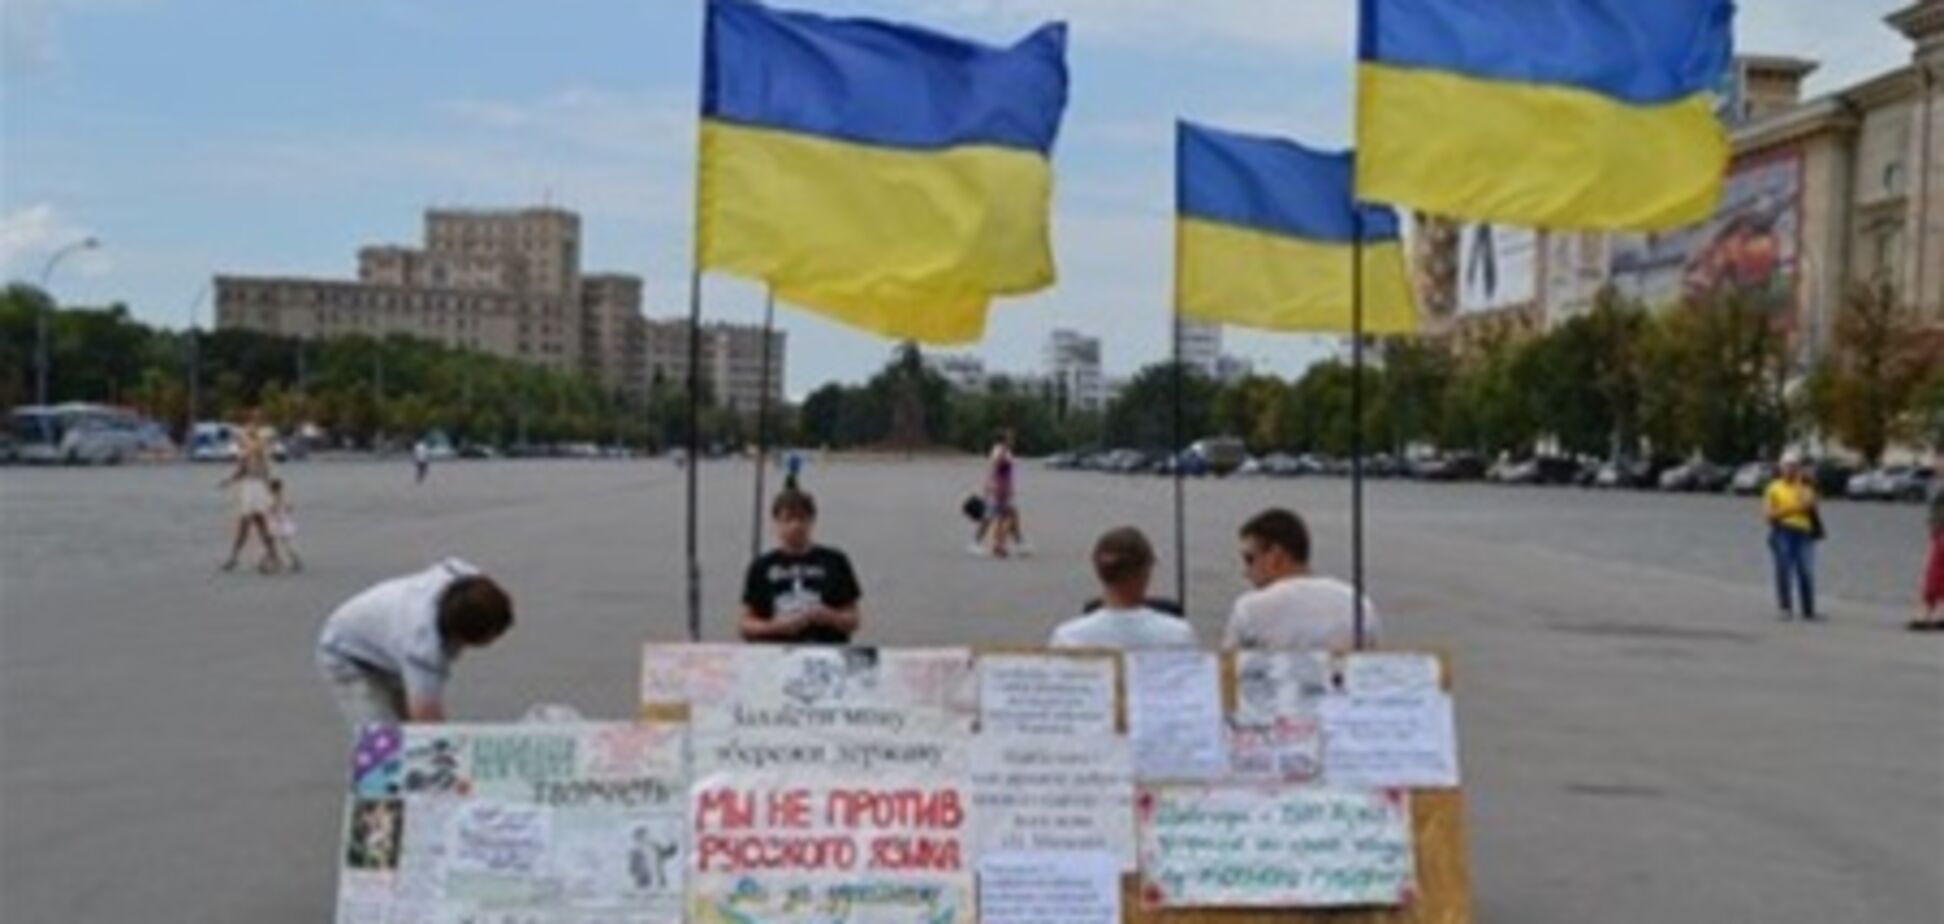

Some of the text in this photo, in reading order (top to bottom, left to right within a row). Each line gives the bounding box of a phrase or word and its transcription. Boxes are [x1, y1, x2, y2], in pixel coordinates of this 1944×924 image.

[696, 787, 756, 830] МЫ
[768, 788, 812, 829] НЕ
[826, 787, 965, 830] ПРОТИВ
[698, 834, 962, 872] РУССКОГО ЯЗЫКА
